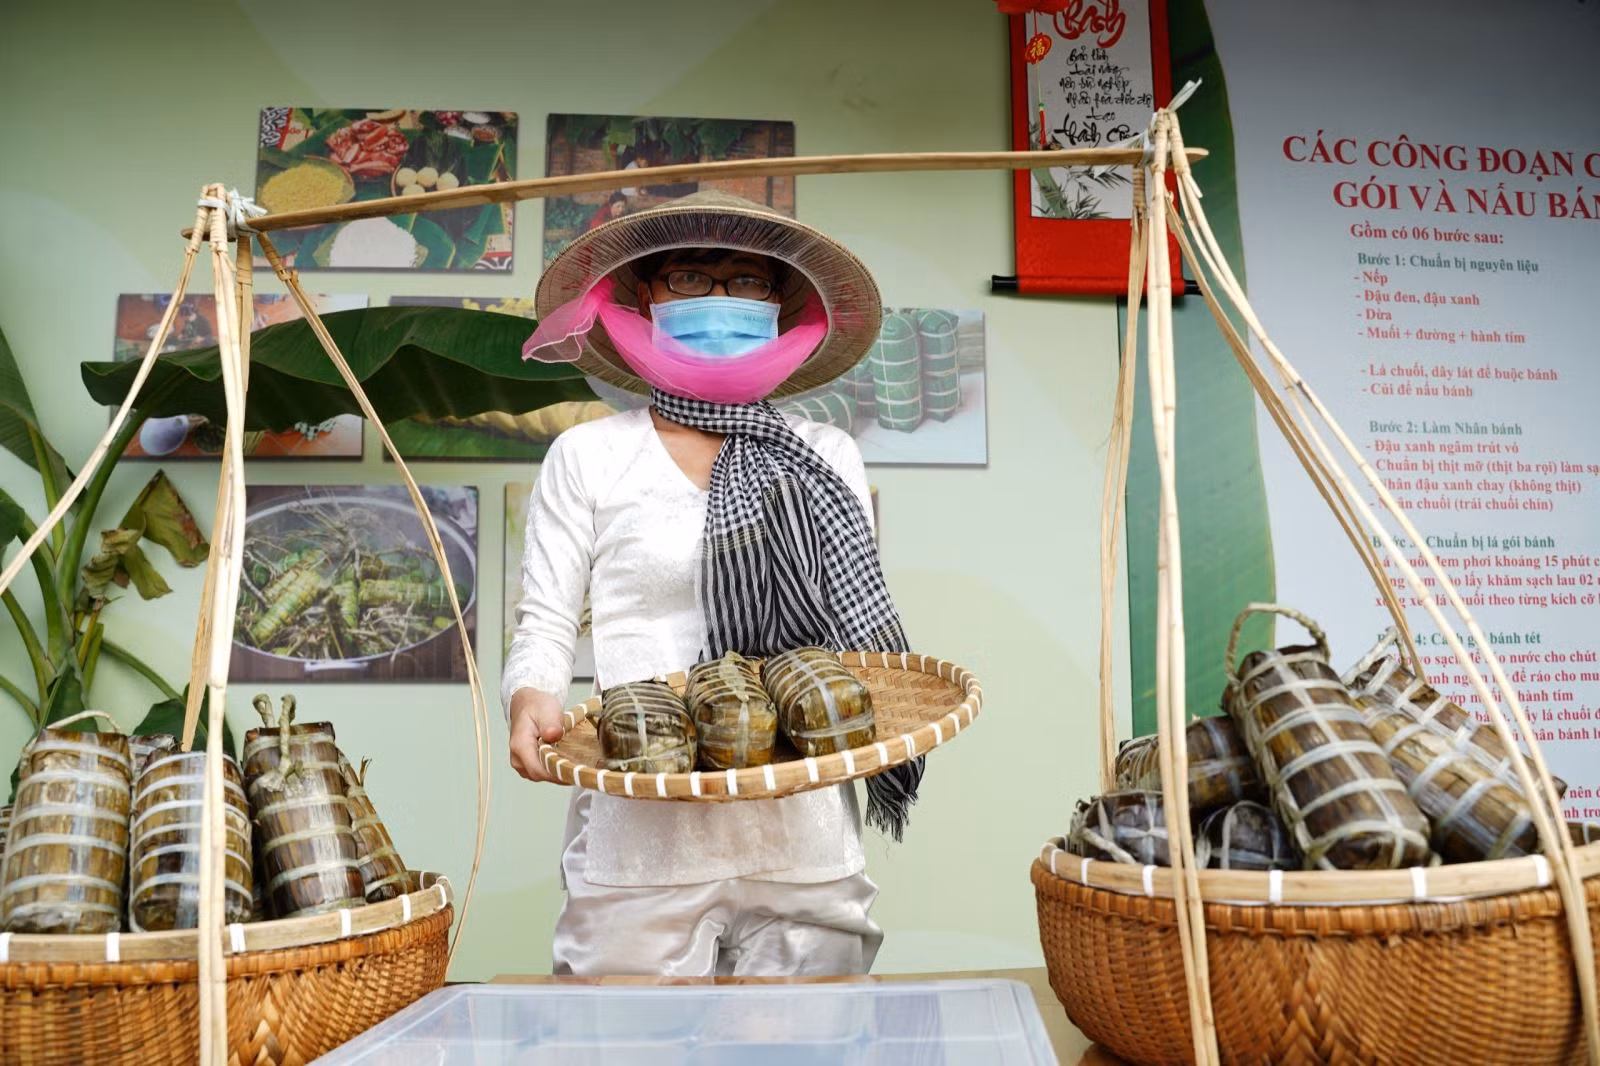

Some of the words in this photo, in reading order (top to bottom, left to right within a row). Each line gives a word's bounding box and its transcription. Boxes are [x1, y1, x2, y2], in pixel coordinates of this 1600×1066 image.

[1030, 38, 1045, 59] 福
[1282, 129, 1358, 165] CÁC
[1367, 134, 1468, 172] CÔNG
[1476, 147, 1574, 183] ĐOẠN
[1332, 175, 1400, 211] GÓI
[1408, 179, 1457, 214] VÀ
[1466, 182, 1536, 217] NẤU
[1350, 219, 1387, 240] Gồm
[1392, 225, 1408, 240] có
[1412, 226, 1430, 241] 06
[1433, 228, 1471, 243] bước
[1474, 231, 1504, 245] sau:
[1358, 252, 1391, 267] Bước
[1395, 254, 1407, 267] 1:
[1409, 249, 1451, 268] Chuẩn
[1454, 256, 1467, 272] bị
[1470, 258, 1514, 273] nguyên
[1517, 259, 1539, 275] liệu
[1362, 268, 1389, 287] Nếp
[1364, 289, 1391, 305] Đậu
[1394, 291, 1421, 304] đen,
[1423, 292, 1447, 308] đậu
[1450, 294, 1480, 306] xanh
[1365, 307, 1393, 321] Dừa
[1367, 323, 1401, 340] Muối
[1415, 328, 1456, 344] đường
[1471, 330, 1501, 343] hành
[1504, 331, 1526, 344] tím
[1369, 363, 1387, 377] Lá
[1494, 368, 1524, 384] buộc
[1527, 367, 1558, 381] bánh
[1443, 384, 1474, 398] bánh
[1369, 419, 1403, 434] Bước
[1406, 421, 1418, 434] 2:
[1422, 420, 1451, 435] Làm
[1455, 422, 1488, 436] Nhân
[1491, 422, 1523, 436] bánh
[1375, 439, 1401, 456] Đậu
[1404, 441, 1435, 453] xanh
[1439, 441, 1474, 456] ngâm
[1375, 455, 1418, 472] Chuẩn
[1422, 459, 1435, 475] bị
[1438, 459, 1459, 474] thịt
[1486, 460, 1513, 475] (thịt
[1516, 460, 1532, 473] ba
[1535, 460, 1557, 475] rọi)
[1560, 460, 1584, 473] làm
[1415, 478, 1440, 495] đậu
[1443, 479, 1473, 492] xanh
[1477, 480, 1505, 495] chay
[1508, 479, 1552, 495] (không
[1555, 479, 1582, 495] thịt)
[1454, 498, 1481, 512] (trái
[1485, 495, 1519, 510] chuối
[1522, 498, 1554, 513] chín)
[1425, 532, 1468, 549] Chuẩn
[1471, 536, 1484, 551] bị
[1487, 535, 1499, 549] lá
[1502, 536, 1521, 551] gói
[1524, 535, 1555, 549] bánh
[1463, 555, 1491, 570] phơi
[1545, 555, 1558, 567] 15
[1562, 554, 1591, 570] phút
[1526, 574, 1553, 589] sạch
[1557, 574, 1576, 586] lau
[1579, 573, 1594, 586] 02
[1435, 593, 1446, 606] lá
[1488, 593, 1515, 606] theo
[1519, 593, 1548, 608] từng
[1551, 592, 1577, 606] kích
[1490, 632, 1521, 645] bánh
[1525, 632, 1541, 645] tét
[1510, 650, 1541, 664] nước
[1544, 650, 1566, 663] cho
[1569, 650, 1597, 663] chút
[1512, 667, 1527, 683] để
[1530, 670, 1551, 683] ráo
[1554, 670, 1577, 682] cho
[1518, 689, 1549, 703] hành
[1552, 688, 1574, 702] tím
[1542, 708, 1553, 721] lá
[1557, 704, 1591, 721] chuối
[1558, 727, 1590, 740] bánh
[1570, 785, 1592, 799] nên
